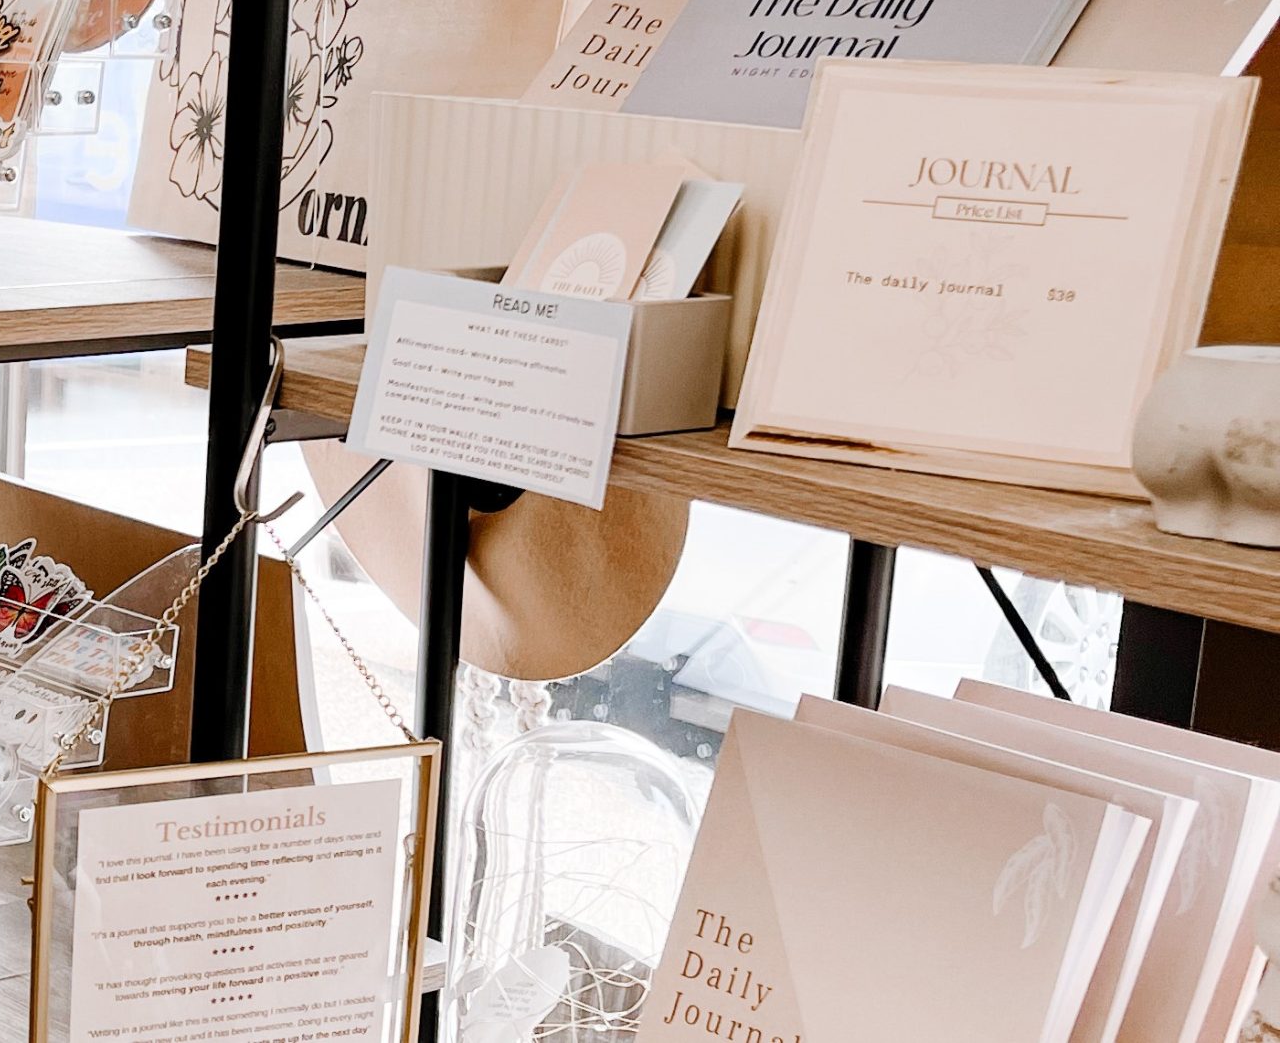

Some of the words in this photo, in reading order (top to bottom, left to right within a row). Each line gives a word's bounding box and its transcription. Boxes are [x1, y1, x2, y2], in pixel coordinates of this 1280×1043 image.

[606, 3, 663, 35] The
[580, 34, 652, 67] Dail
[733, 31, 900, 59] Journal
[550, 65, 628, 97] Jour
[731, 67, 780, 78] NIGHT
[908, 157, 1080, 195] JOURNAL
[298, 189, 368, 246] orn
[956, 203, 995, 219] Price
[996, 205, 1023, 220] List
[846, 271, 872, 285] The
[882, 275, 928, 293] daily
[939, 283, 1003, 297] journal
[1047, 288, 1075, 302] $30
[492, 293, 529, 314] READ
[535, 304, 559, 319] ME!
[155, 806, 326, 843] Testimonials
[228, 846, 250, 854] using
[96, 876, 111, 884] find
[113, 875, 129, 883] that
[159, 868, 192, 877] forward
[207, 862, 248, 872] spending
[272, 856, 313, 864] reflecting
[316, 852, 332, 860] and
[206, 880, 227, 888] each
[134, 938, 170, 947] through
[207, 928, 262, 938] mindfulness
[266, 924, 282, 932] and
[695, 909, 753, 954] The
[680, 950, 773, 1011] Daily
